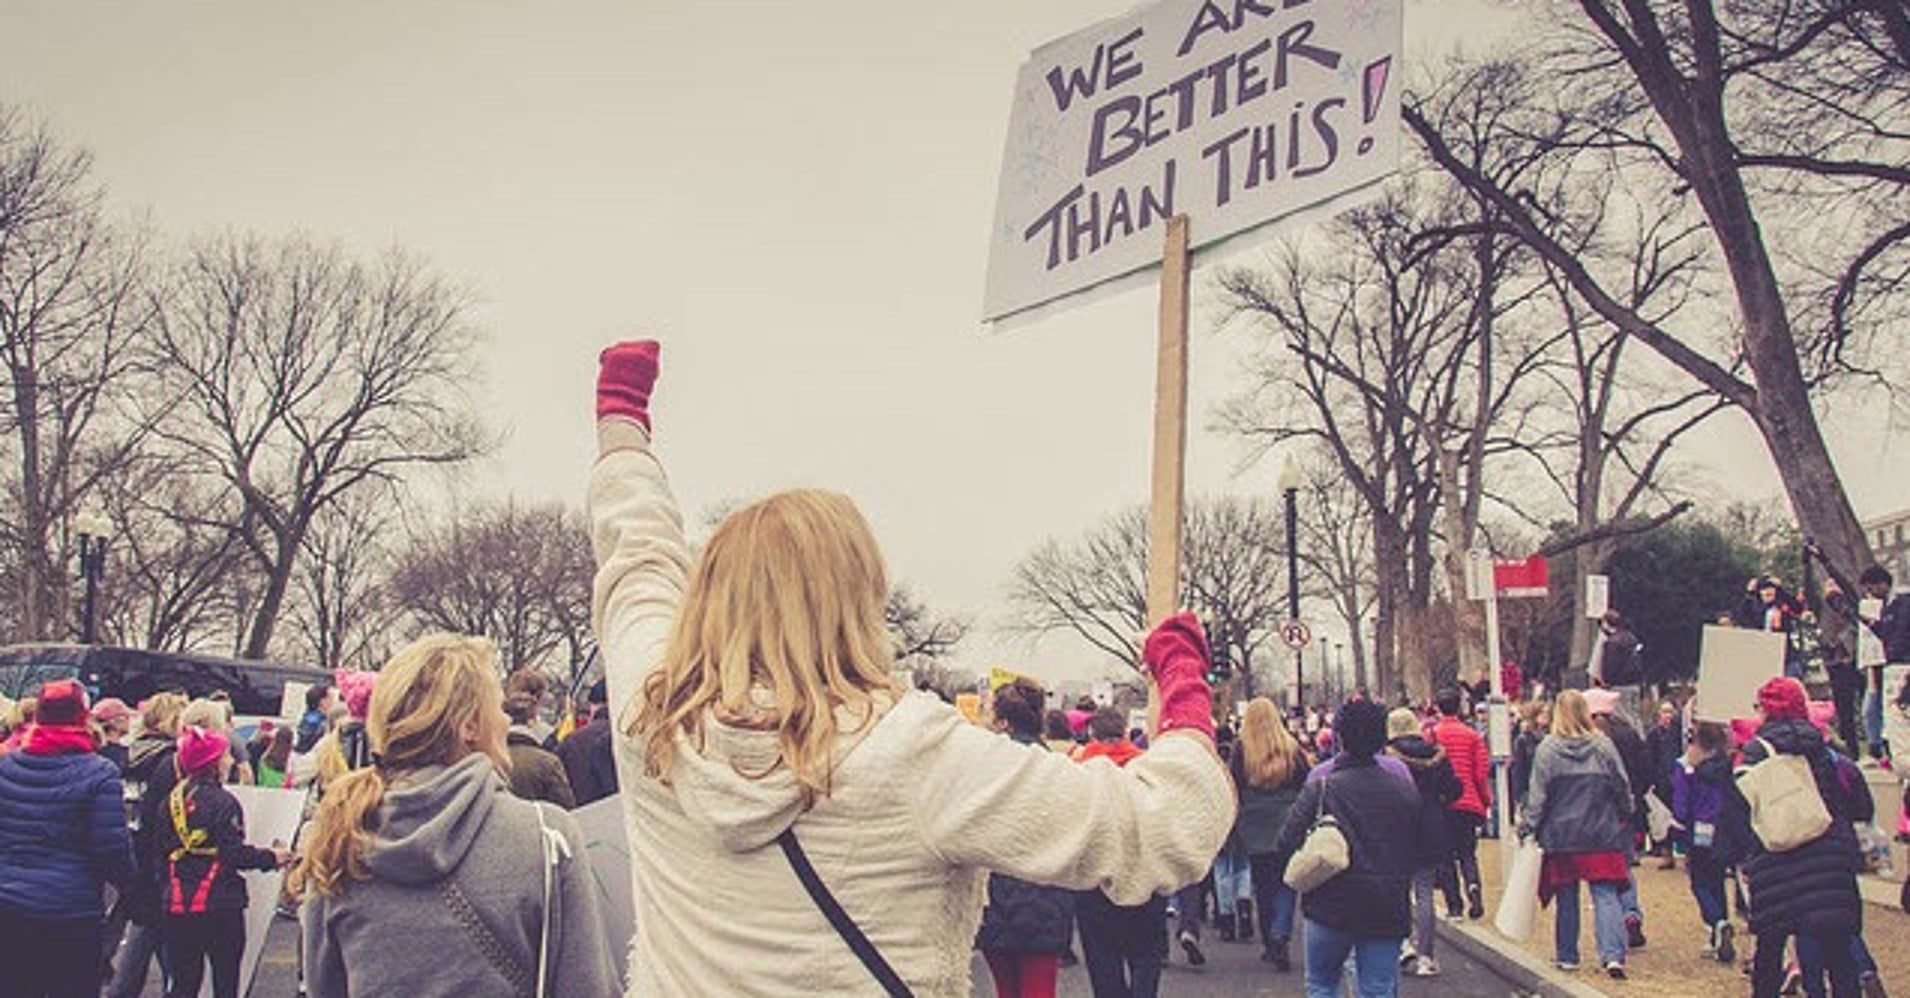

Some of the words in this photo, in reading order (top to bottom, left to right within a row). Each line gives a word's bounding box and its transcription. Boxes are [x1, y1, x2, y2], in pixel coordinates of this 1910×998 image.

[1045, 27, 1144, 113] WE
[1085, 20, 1342, 178] BETTER
[1024, 159, 1176, 271] THAN
